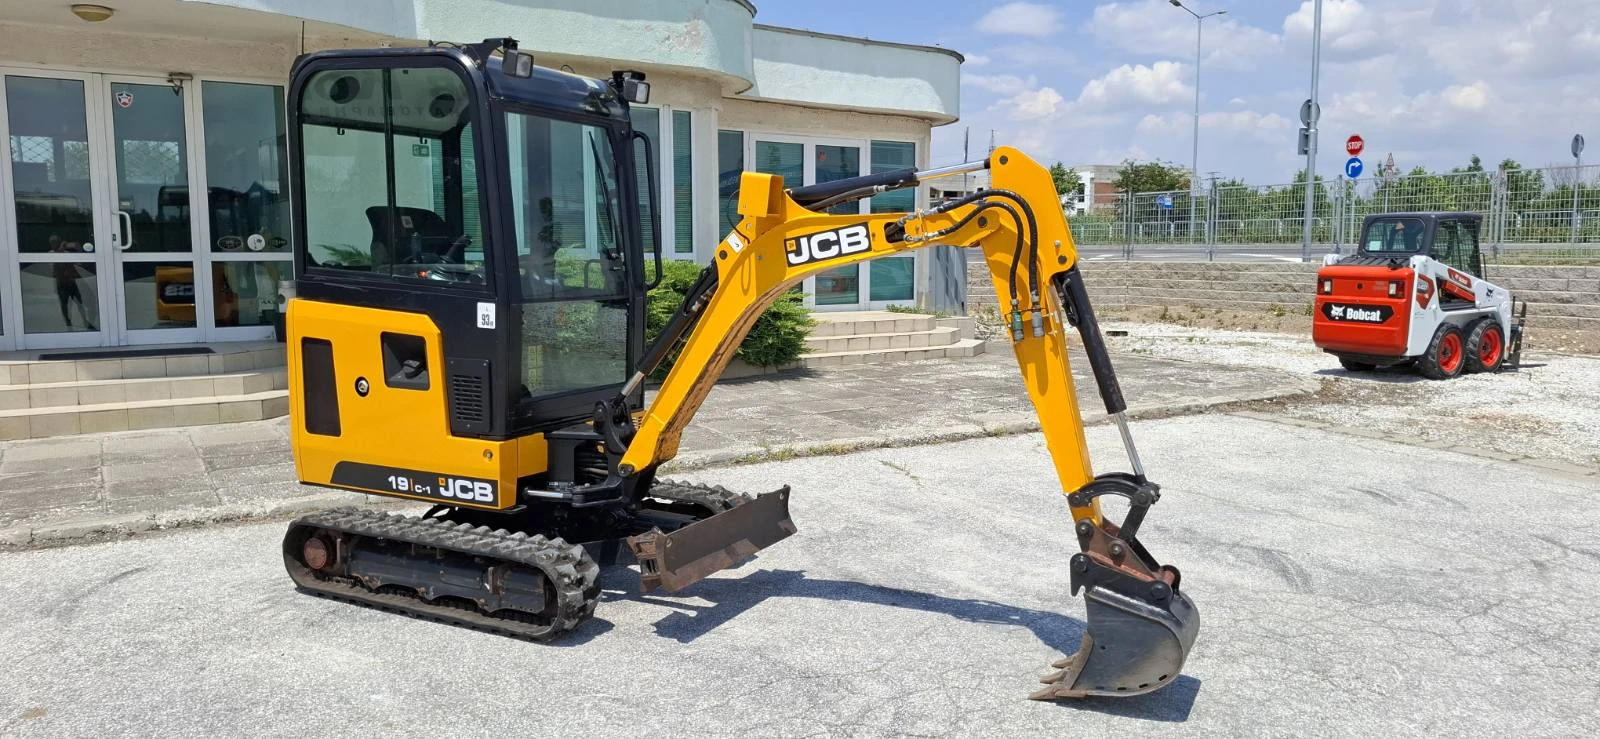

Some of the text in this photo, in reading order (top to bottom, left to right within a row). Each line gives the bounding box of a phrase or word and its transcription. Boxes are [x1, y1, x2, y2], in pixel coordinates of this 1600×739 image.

[1347, 141, 1362, 150] STOP
[787, 225, 870, 265] JCB
[481, 313, 490, 326] 93
[1346, 307, 1381, 321] Bobcat
[388, 475, 409, 491] 19
[439, 477, 494, 502] JCB
